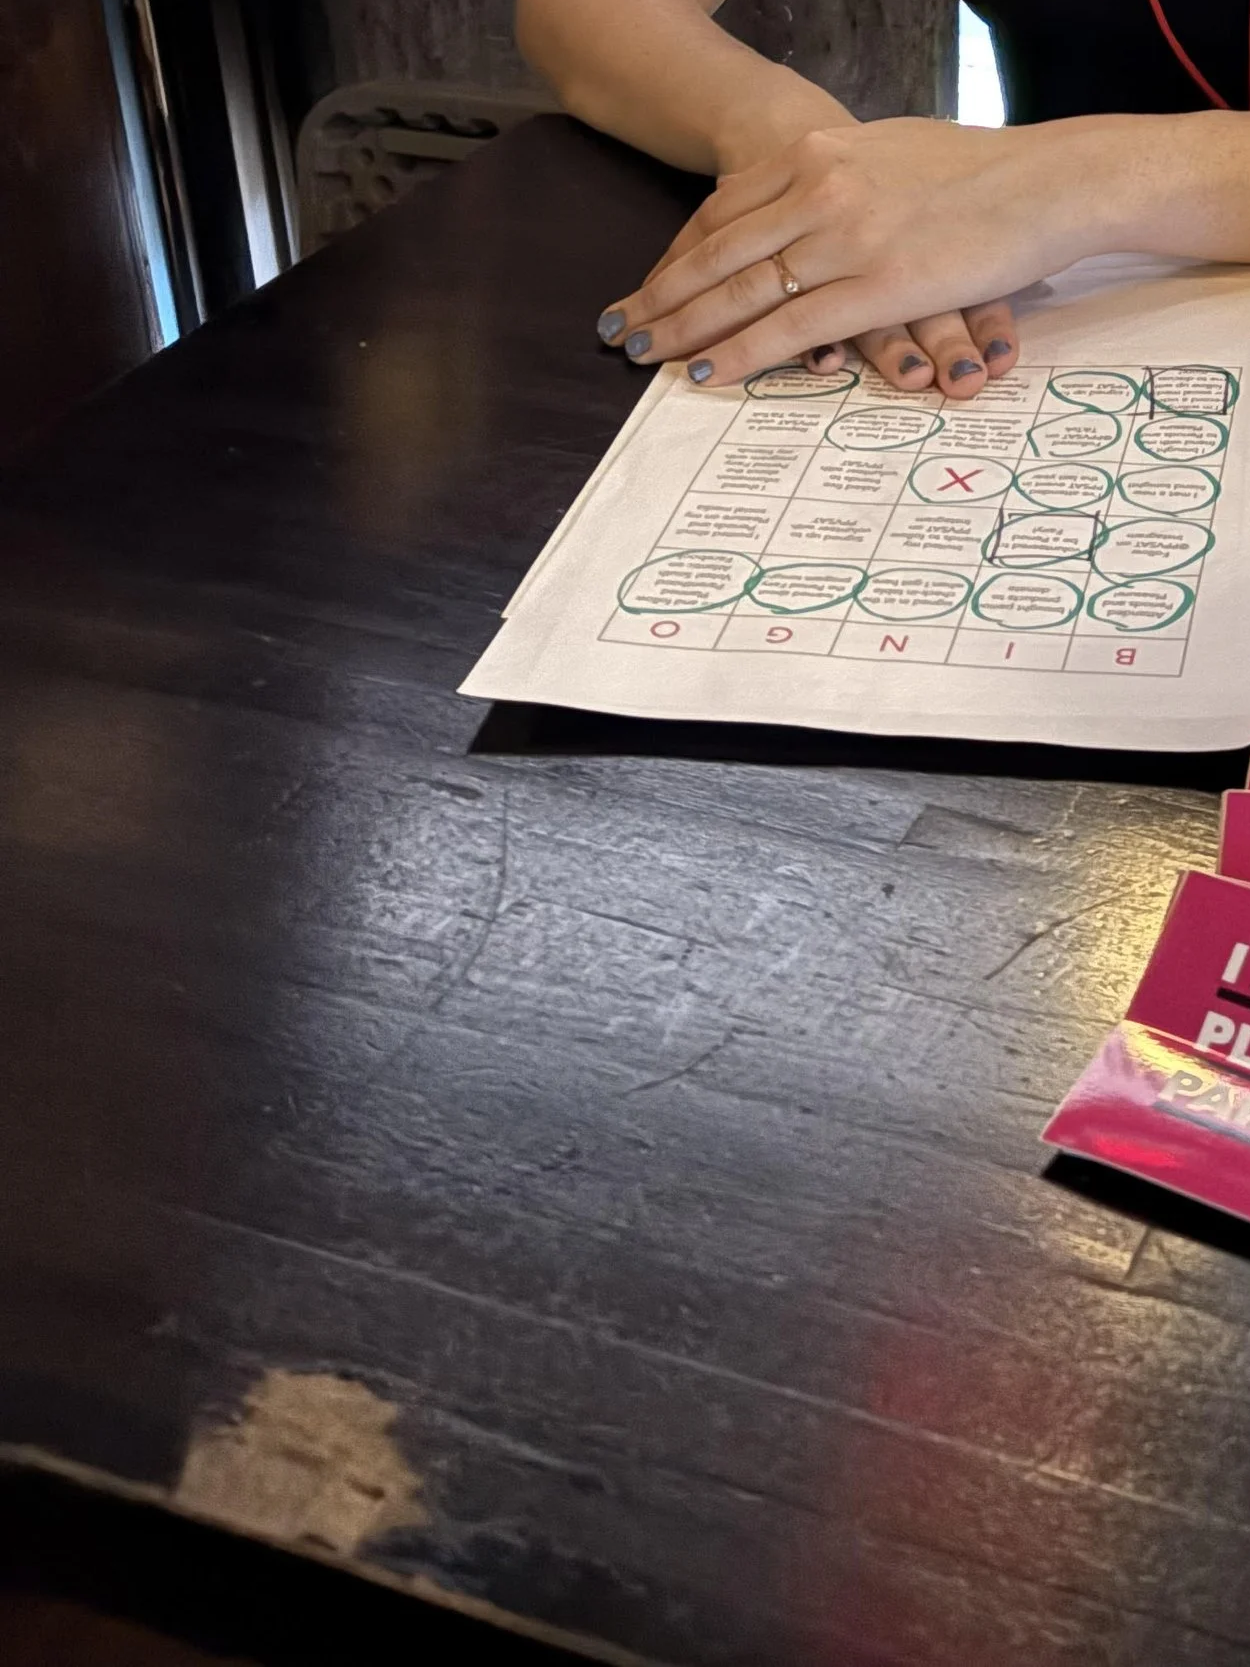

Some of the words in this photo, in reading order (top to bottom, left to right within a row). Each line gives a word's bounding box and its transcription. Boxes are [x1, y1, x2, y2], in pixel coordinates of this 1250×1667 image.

[1101, 599, 1125, 608] and
[650, 620, 680, 638] O
[766, 626, 793, 643] G
[880, 635, 908, 652] N
[1117, 650, 1135, 665] B
[1222, 942, 1250, 984] I
